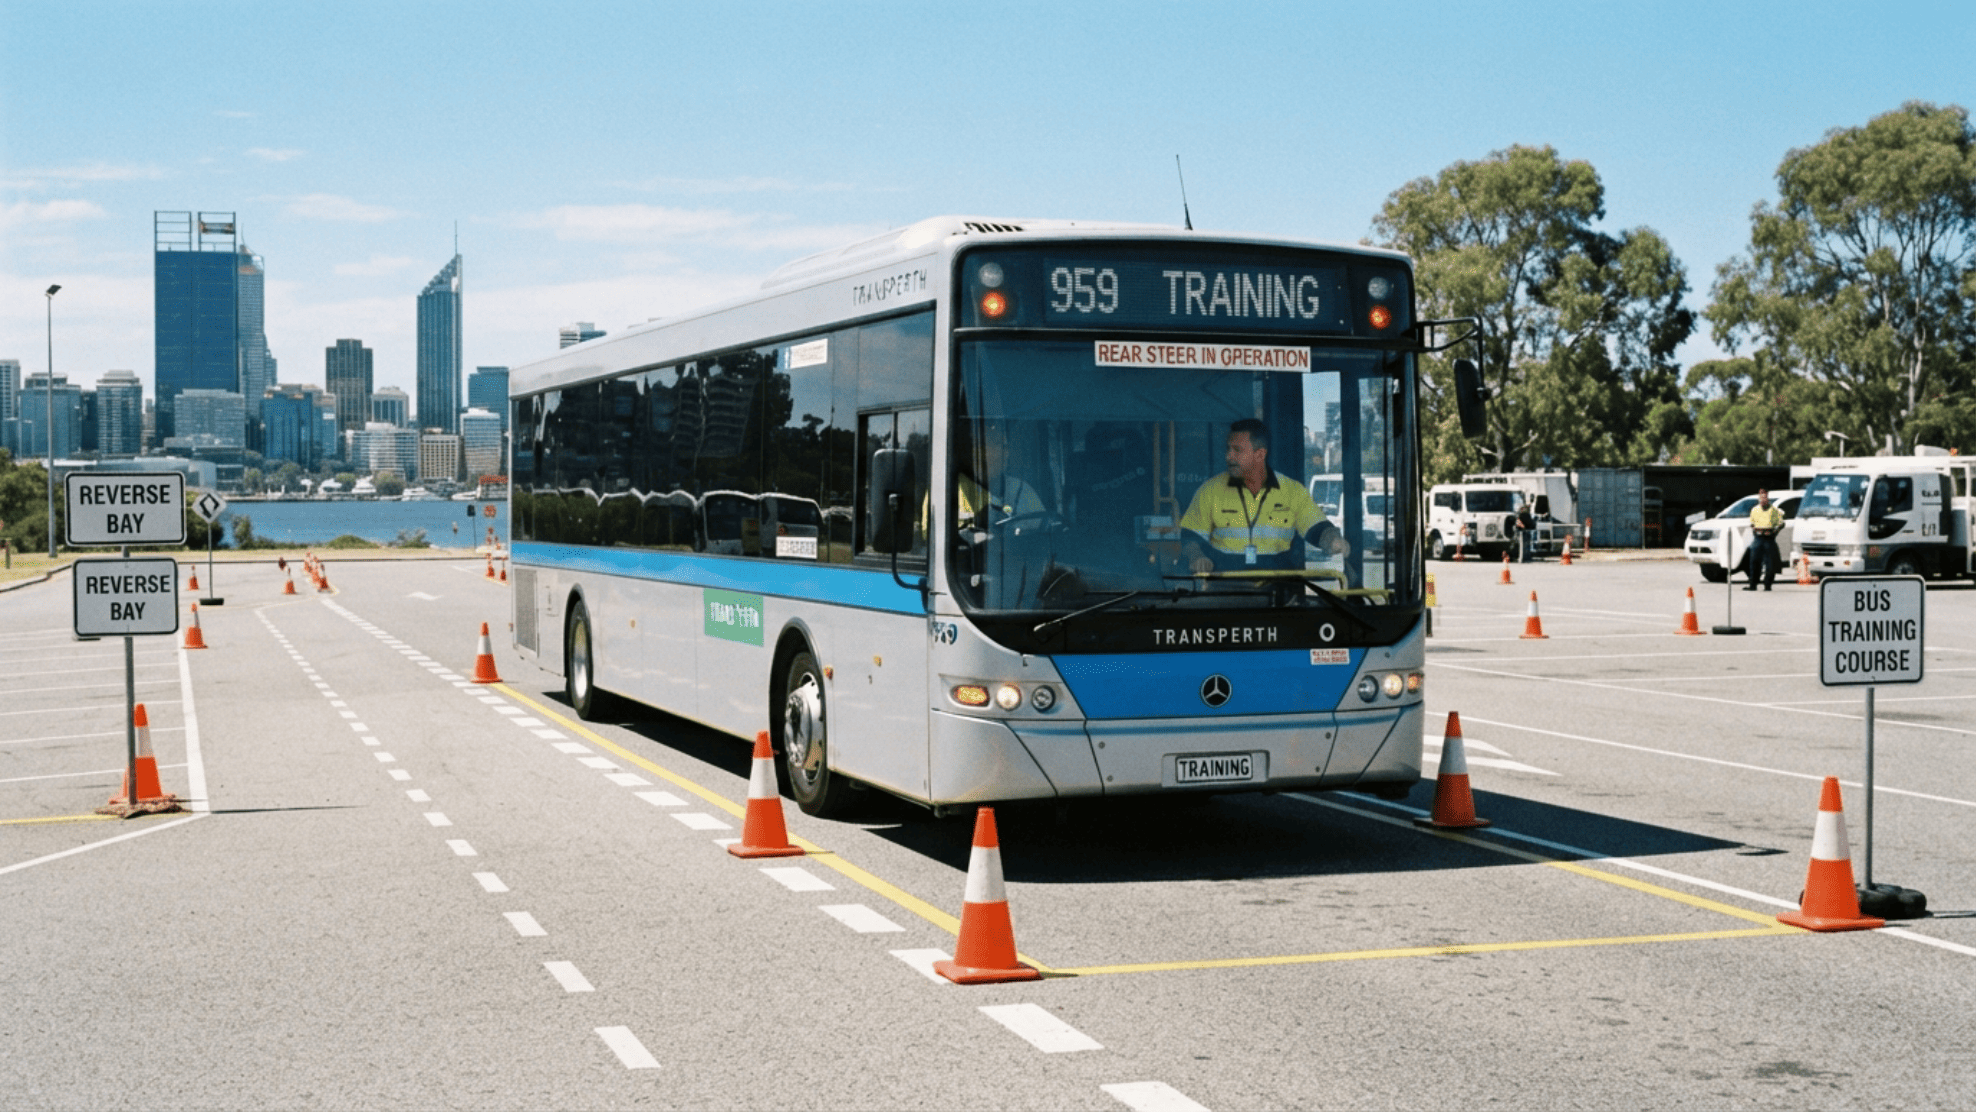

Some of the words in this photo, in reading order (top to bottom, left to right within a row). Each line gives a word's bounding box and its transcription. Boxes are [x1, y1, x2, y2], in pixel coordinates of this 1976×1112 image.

[1050, 267, 1119, 313] 959
[1162, 270, 1319, 319] TRAINING
[1098, 344, 1142, 363] REAR
[1146, 345, 1197, 364] STEER
[1201, 347, 1216, 364] IN
[79, 484, 171, 505] REVERSE
[106, 513, 144, 533] BAY
[86, 575, 171, 594] REVERSE
[1854, 589, 1891, 612] BUS
[110, 602, 146, 620] BAY
[1153, 626, 1278, 645] TRANSPERTH
[1828, 619, 1916, 642] TRAINING
[1835, 649, 1910, 673] COURSE
[1179, 758, 1250, 777] TRAINING
